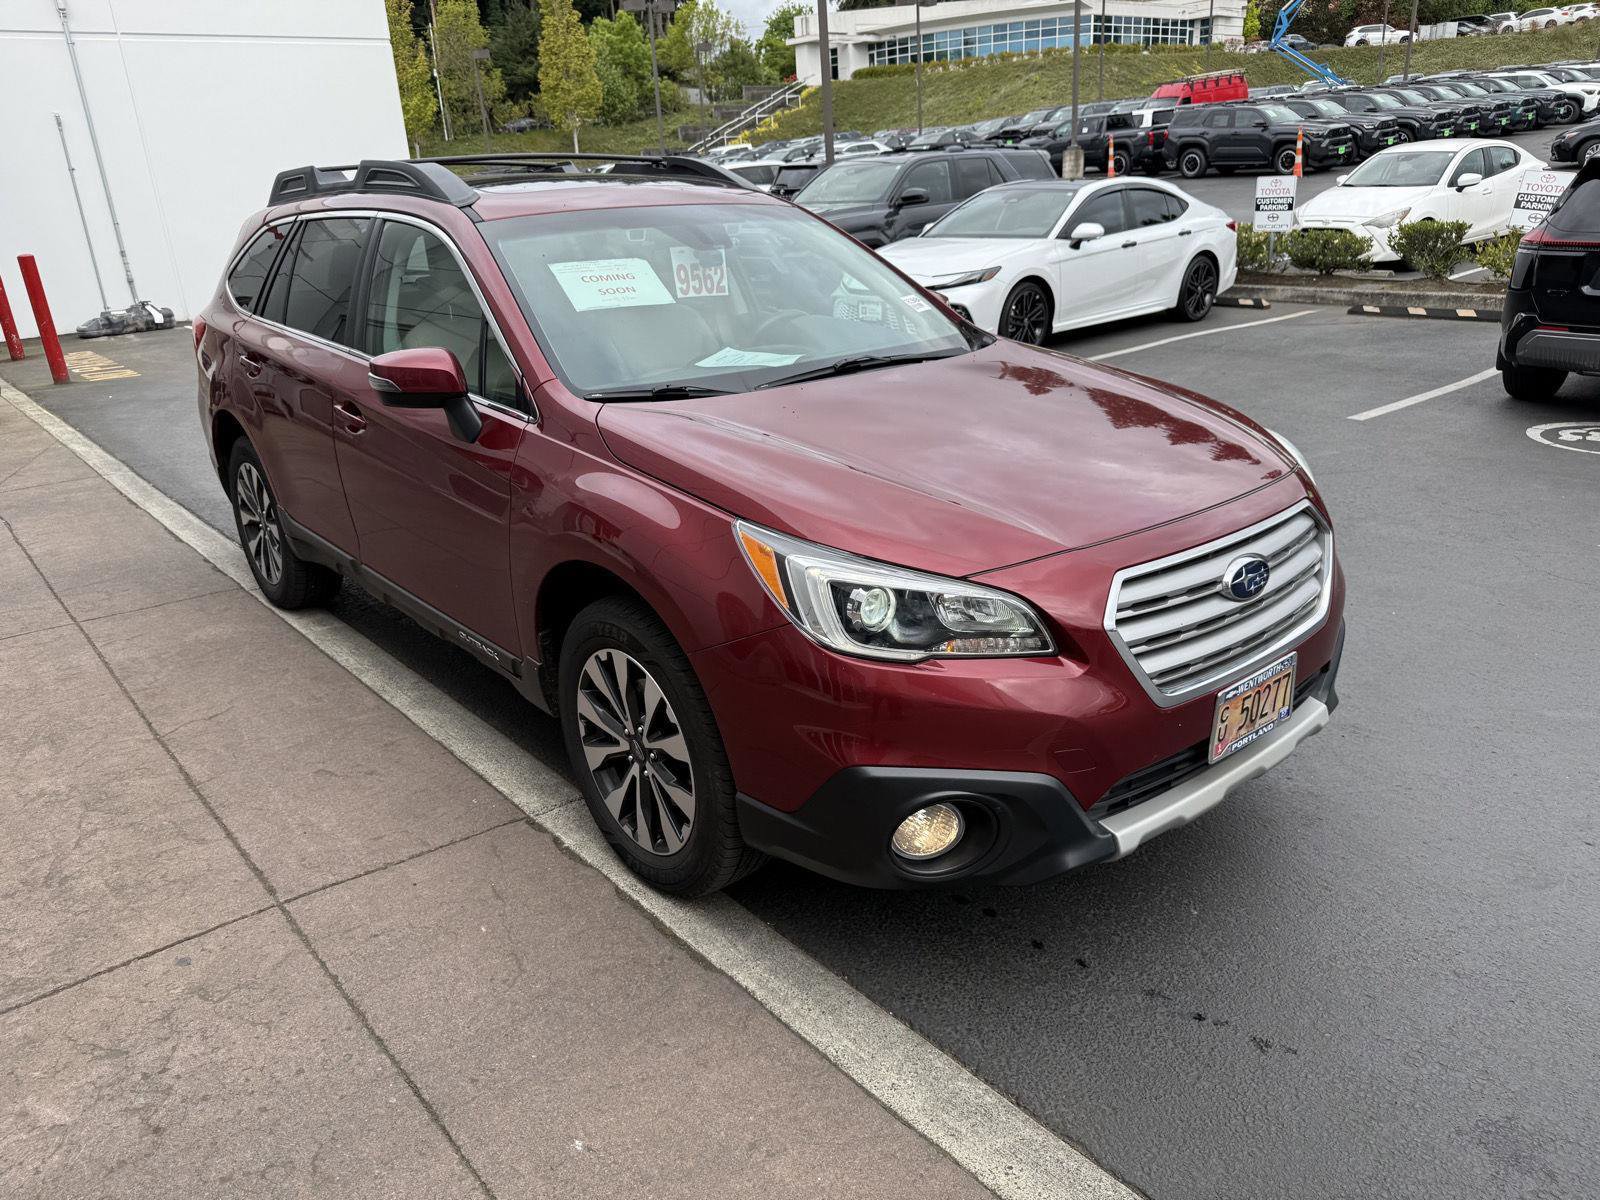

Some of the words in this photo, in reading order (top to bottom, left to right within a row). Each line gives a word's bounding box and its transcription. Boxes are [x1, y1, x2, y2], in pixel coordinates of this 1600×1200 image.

[1260, 187, 1291, 196] TOYOTA
[1526, 182, 1566, 193] TOYOTA
[1256, 197, 1292, 205] CUSTOMER
[1520, 201, 1553, 211] PARKIN
[580, 272, 636, 283] COMING
[675, 263, 726, 296] 9562
[598, 286, 637, 296] SOON
[1237, 664, 1281, 694] WENTWORTH
[1237, 674, 1291, 731] 50277
[1231, 722, 1274, 751] PORTLAND
